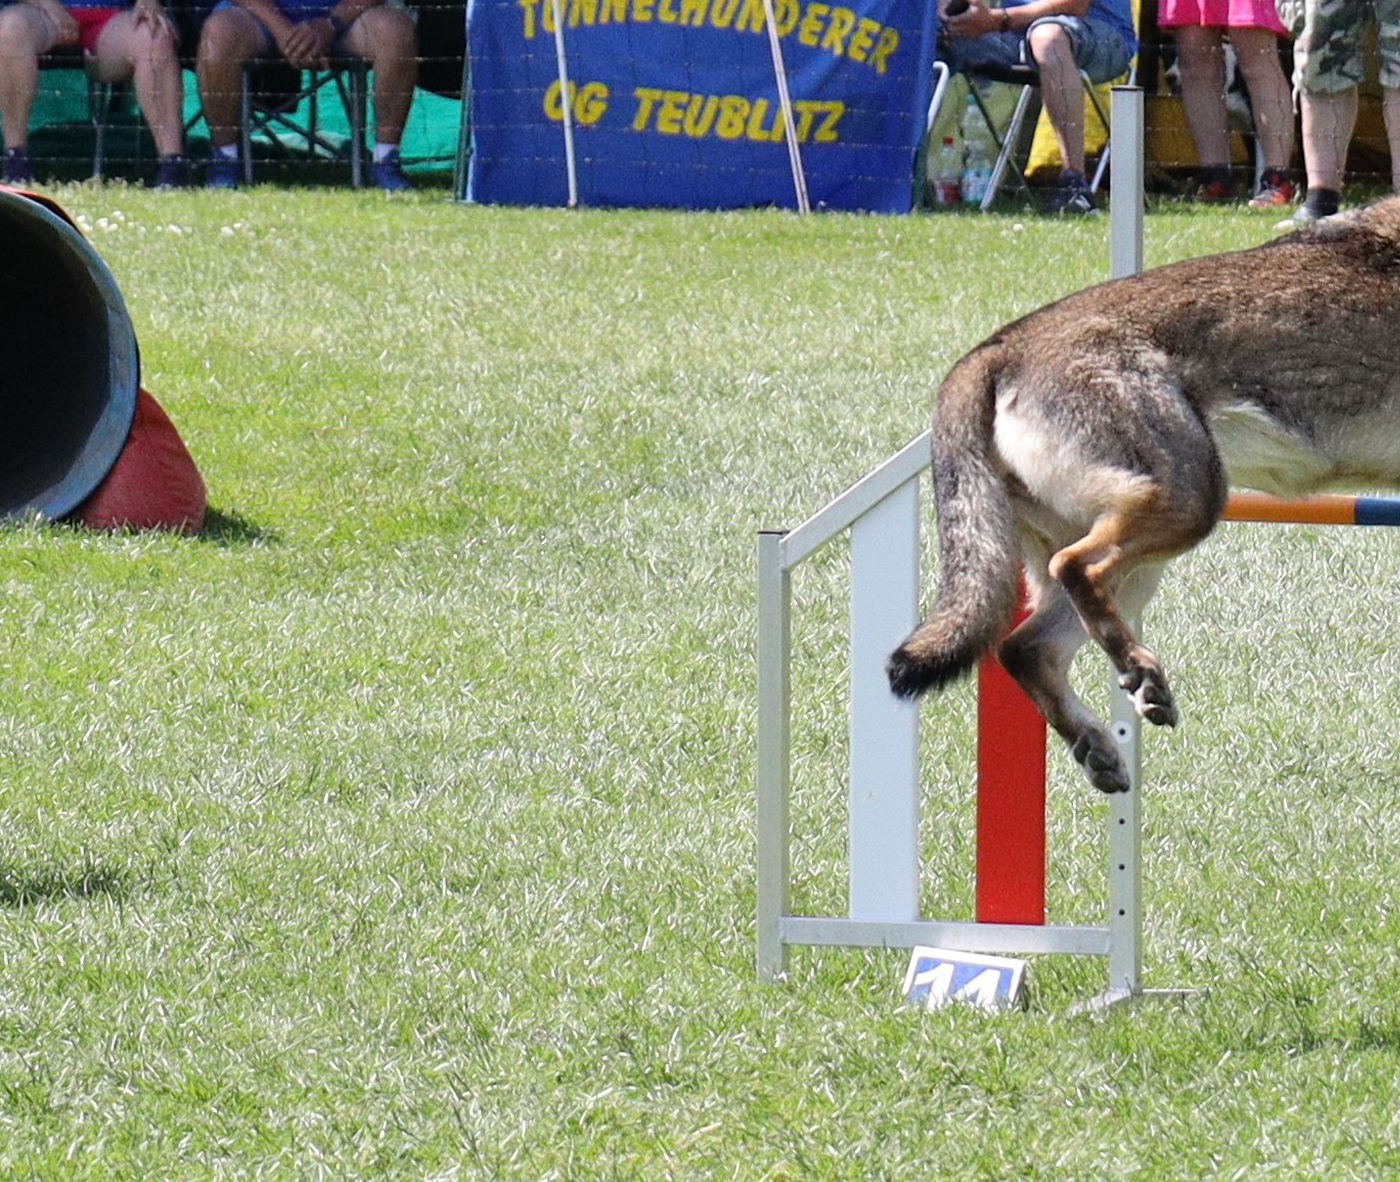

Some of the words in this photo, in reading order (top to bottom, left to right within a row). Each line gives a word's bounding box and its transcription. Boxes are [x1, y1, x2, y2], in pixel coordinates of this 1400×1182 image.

[543, 80, 610, 125] OG
[633, 86, 847, 143] TEUBLITZ
[914, 962, 1002, 1012] 14
